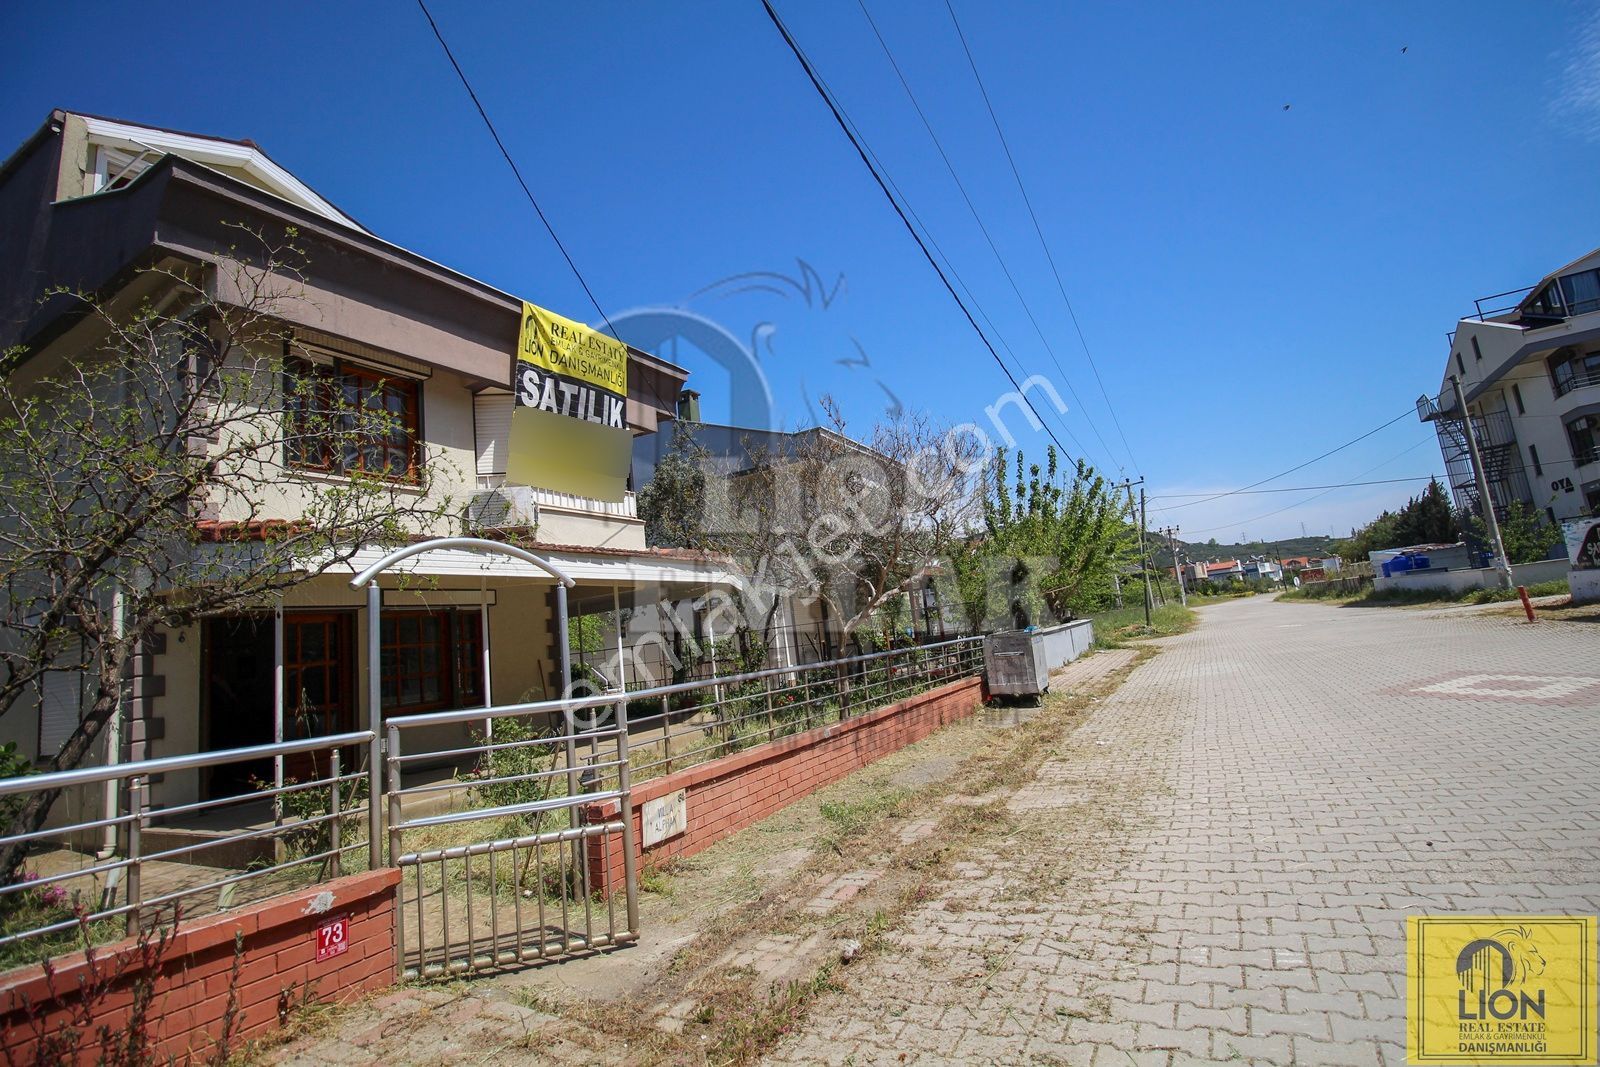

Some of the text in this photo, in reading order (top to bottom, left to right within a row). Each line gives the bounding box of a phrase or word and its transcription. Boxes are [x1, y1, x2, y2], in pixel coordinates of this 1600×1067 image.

[551, 322, 586, 347] REAL
[524, 338, 544, 358] LION
[521, 369, 624, 429] SATILIK
[1551, 477, 1573, 491] OYA
[322, 922, 343, 947] 73
